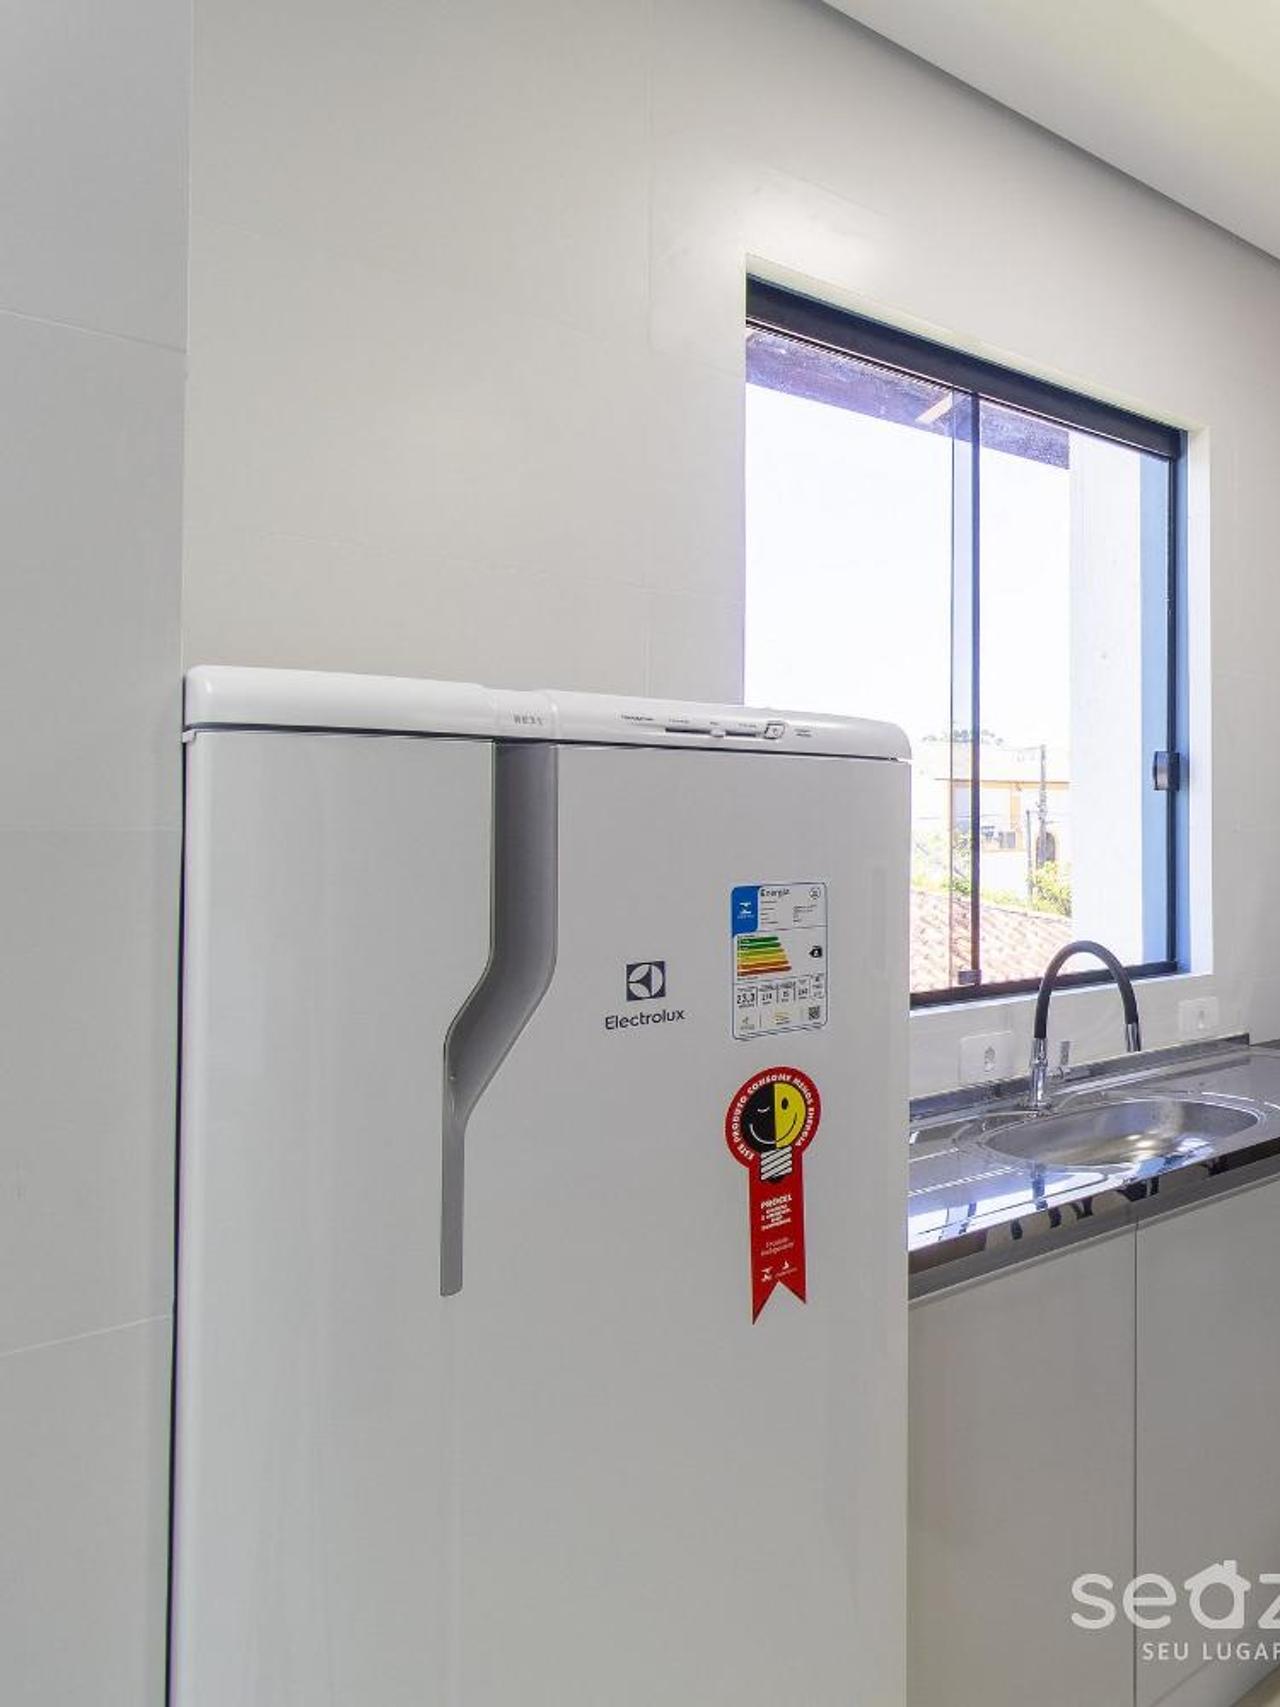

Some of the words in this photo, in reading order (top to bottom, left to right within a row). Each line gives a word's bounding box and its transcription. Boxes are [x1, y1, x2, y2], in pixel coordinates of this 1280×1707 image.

[605, 1009, 686, 1030] Electrolux
[746, 1073, 792, 1095] CONSOME
[792, 1078, 814, 1105] MENOS
[731, 1095, 748, 1143] PRODUTO
[794, 1106, 815, 1146] ENERGIA
